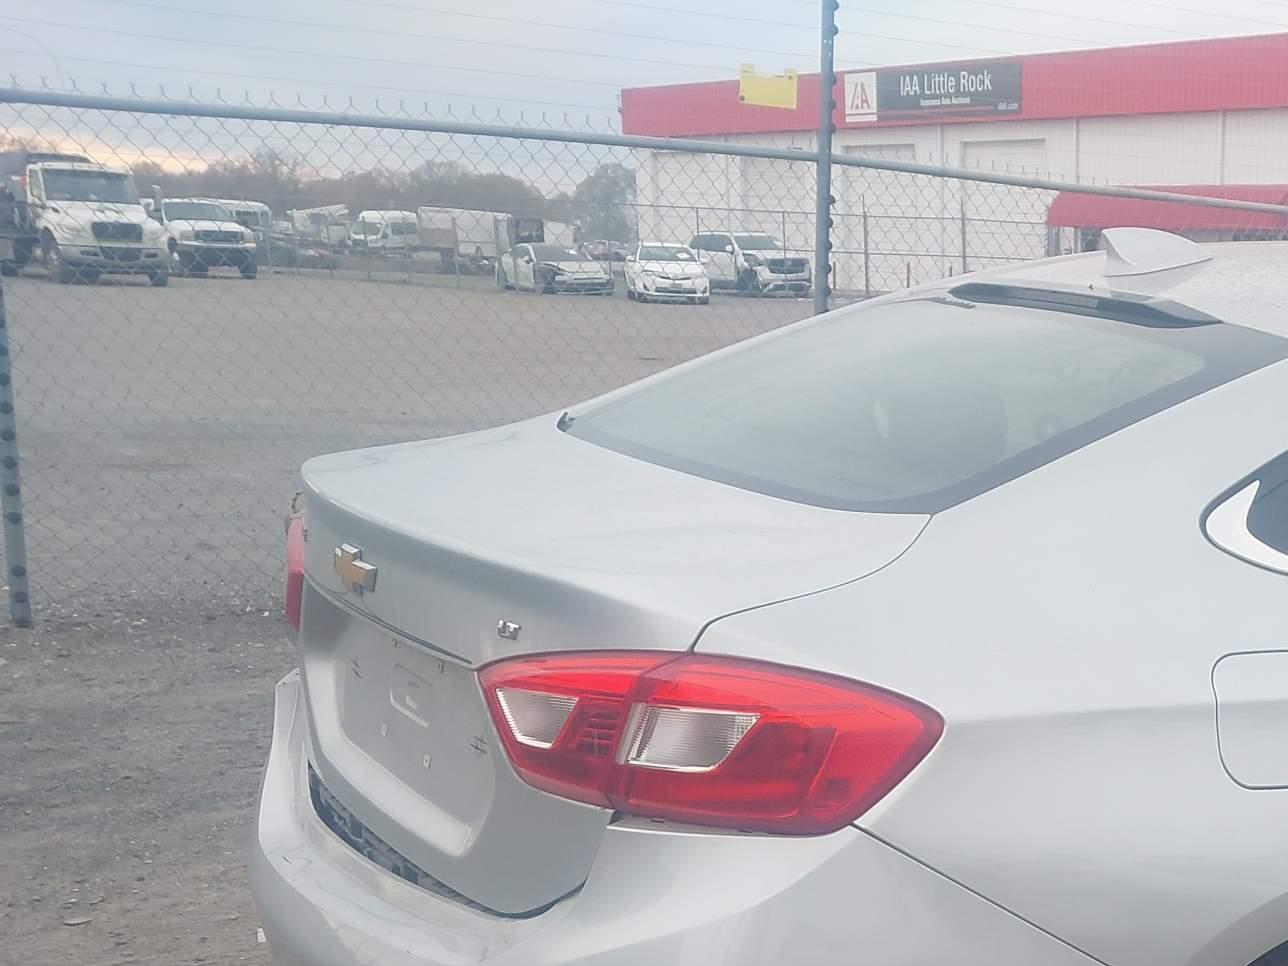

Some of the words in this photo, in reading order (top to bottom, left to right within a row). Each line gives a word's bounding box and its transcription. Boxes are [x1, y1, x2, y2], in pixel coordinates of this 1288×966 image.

[900, 74, 920, 97] IAA
[924, 72, 956, 95] Little
[960, 68, 993, 93] Rock
[497, 619, 521, 640] LT
